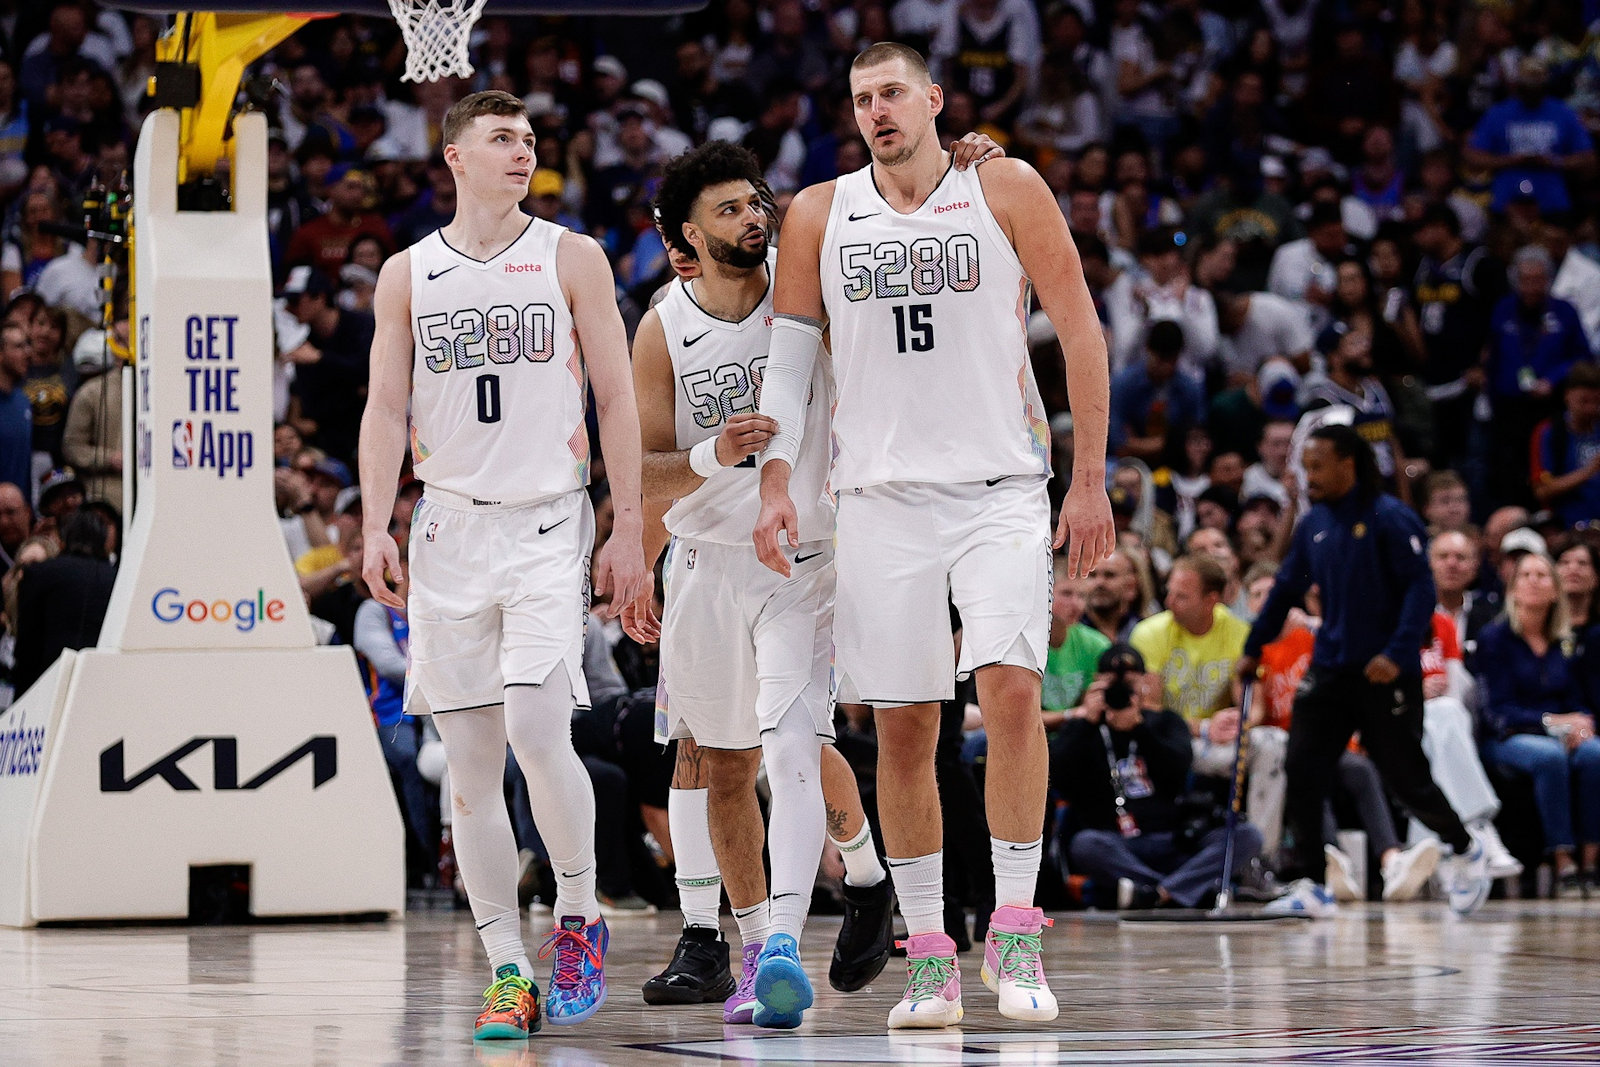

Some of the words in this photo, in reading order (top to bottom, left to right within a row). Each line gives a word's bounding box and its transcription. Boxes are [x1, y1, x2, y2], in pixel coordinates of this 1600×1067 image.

[933, 201, 970, 215] ibotta
[504, 263, 542, 273] ibotta
[840, 233, 980, 302] 5280
[185, 315, 239, 361] GET
[418, 303, 555, 374] 5280
[892, 303, 934, 353] 15
[185, 367, 240, 413] THE
[476, 374, 501, 424] 0
[199, 421, 253, 478] App
[151, 587, 285, 631] Google
[99, 735, 337, 792] KIA
